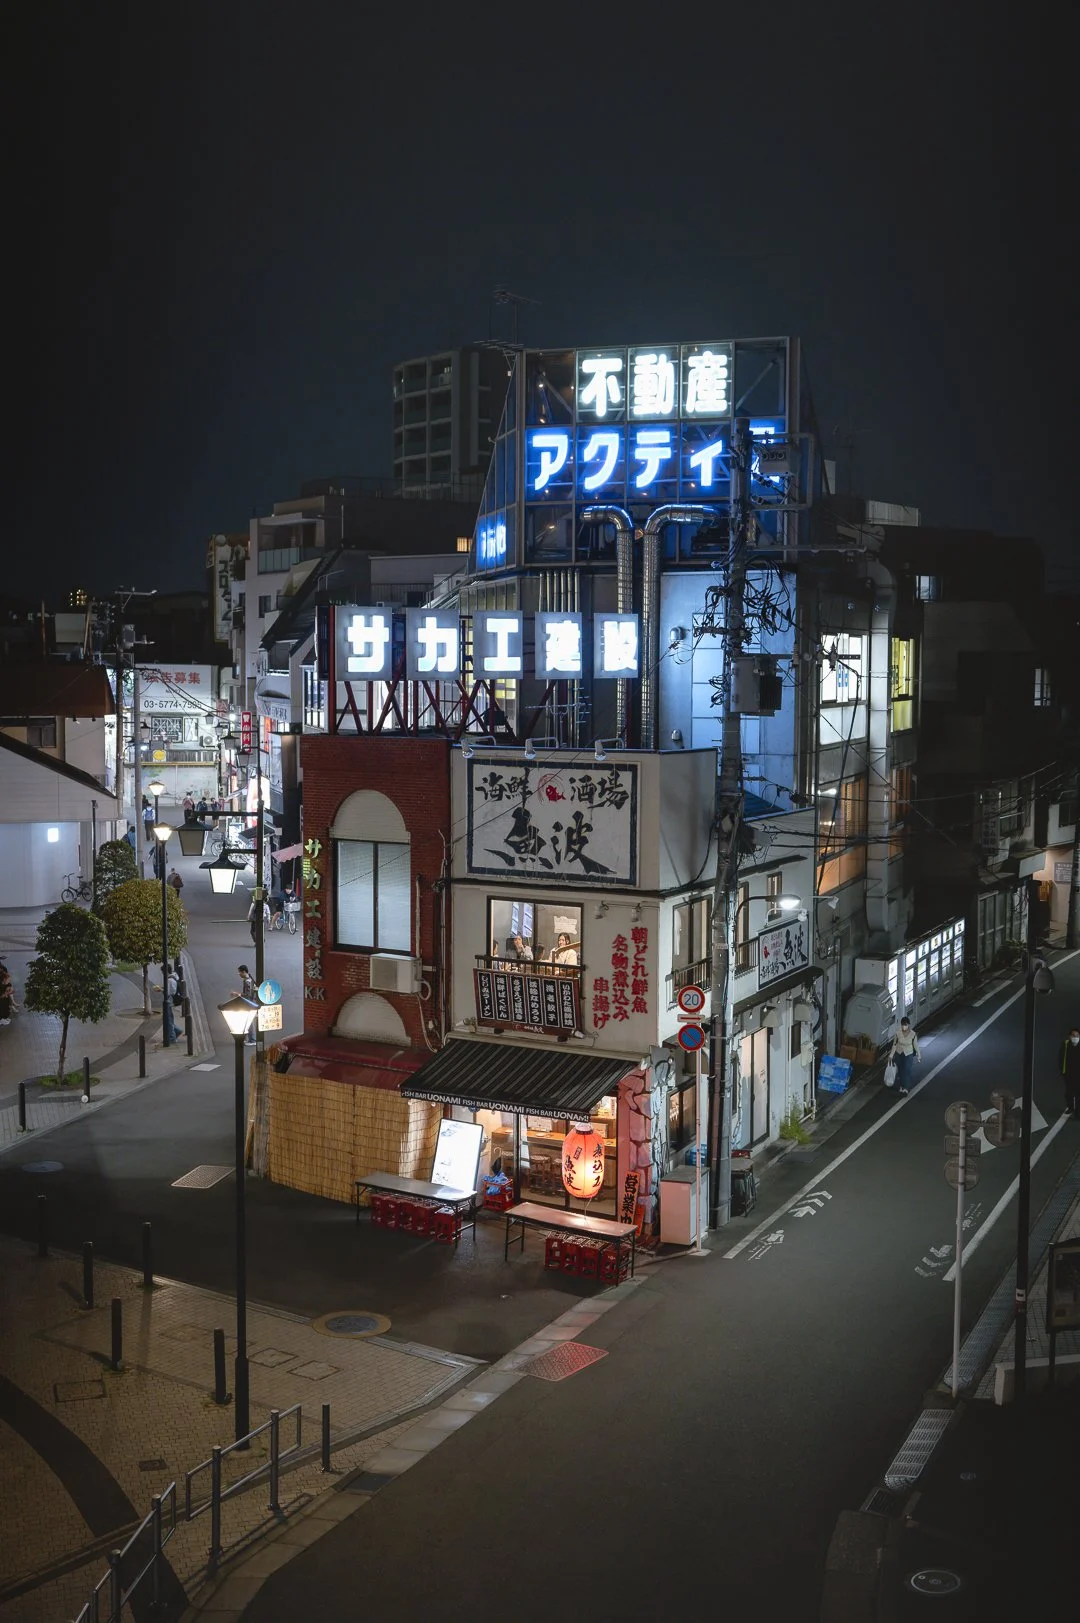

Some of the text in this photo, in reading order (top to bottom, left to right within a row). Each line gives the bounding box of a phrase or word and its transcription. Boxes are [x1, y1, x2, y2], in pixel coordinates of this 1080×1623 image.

[580, 350, 728, 417] 不動産
[475, 767, 630, 810] 海鮮 酒場
[483, 806, 618, 876] 魚波
[304, 838, 322, 979] サカエ建設
[611, 934, 630, 1022] 名物煮込み
[631, 926, 649, 1014] 朝どれ鮮魚
[683, 994, 700, 1006] 20
[592, 976, 611, 1030] 串揚げ
[426, 1093, 461, 1105] UONAMI
[462, 1099, 476, 1107] FISH
[488, 1101, 525, 1113] UONAMI
[525, 1107, 540, 1115] FISH
[540, 1109, 553, 1117] BAR
[564, 1154, 582, 1191] 魚波
